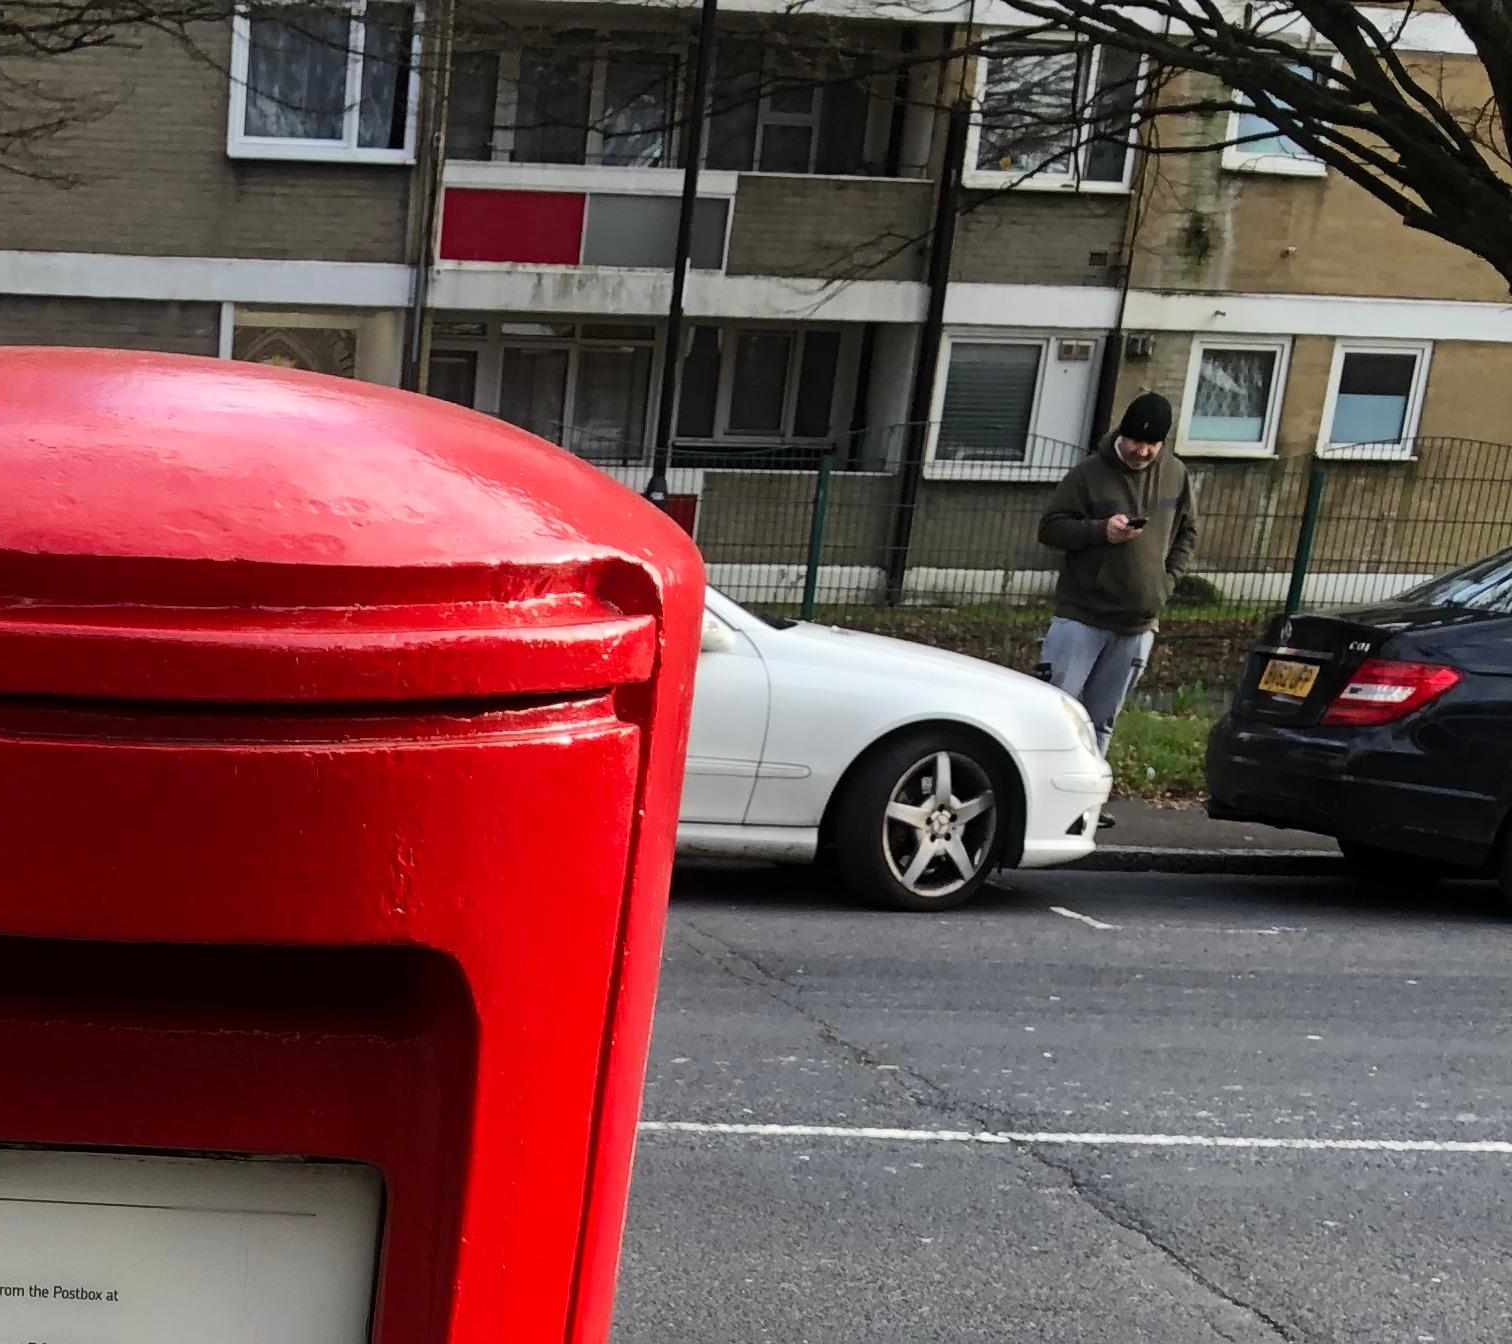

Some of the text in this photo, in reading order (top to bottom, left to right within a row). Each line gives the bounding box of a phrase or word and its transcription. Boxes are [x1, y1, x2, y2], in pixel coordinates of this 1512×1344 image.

[29, 1285, 50, 1299] the
[53, 1285, 103, 1301] Postbox
[106, 1289, 119, 1302] at
